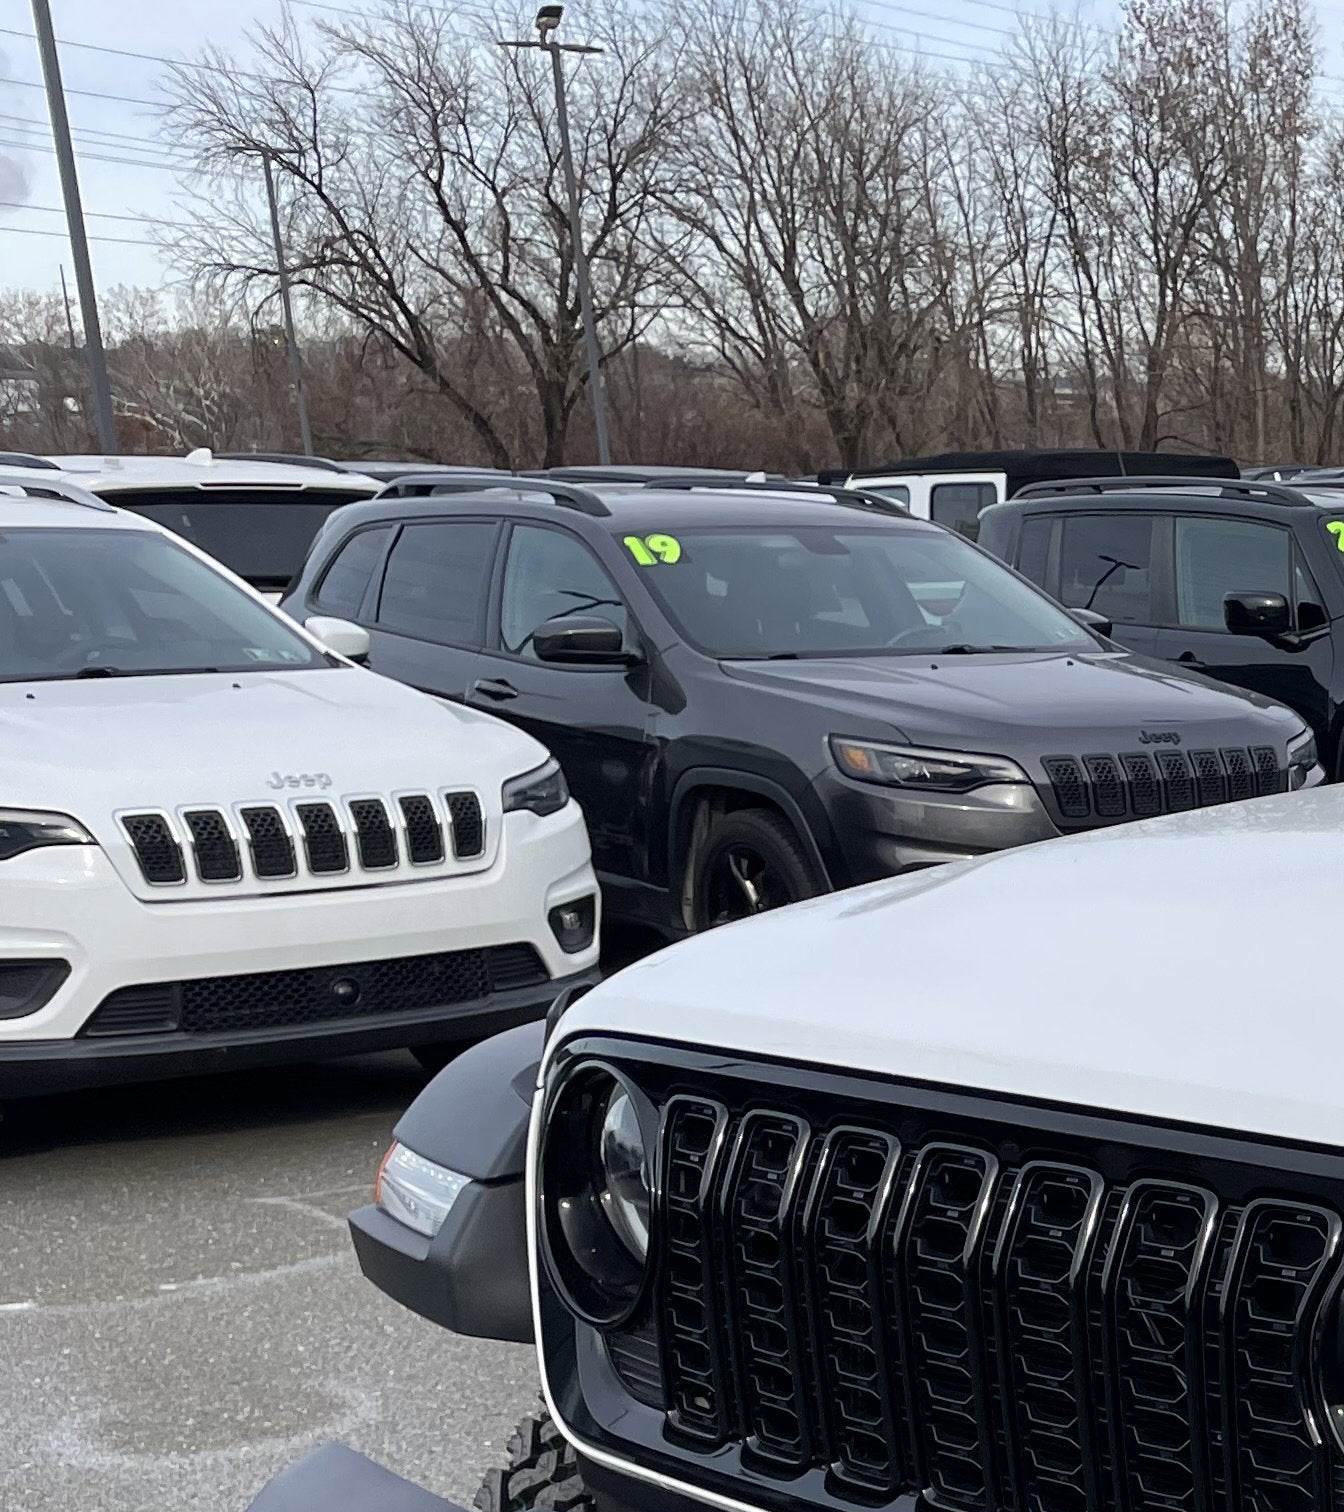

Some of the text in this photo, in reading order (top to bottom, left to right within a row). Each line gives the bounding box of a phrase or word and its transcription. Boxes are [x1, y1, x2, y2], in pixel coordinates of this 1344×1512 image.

[624, 534, 680, 565] 19
[1138, 730, 1181, 745] Jeep
[265, 772, 333, 790] Jeep
